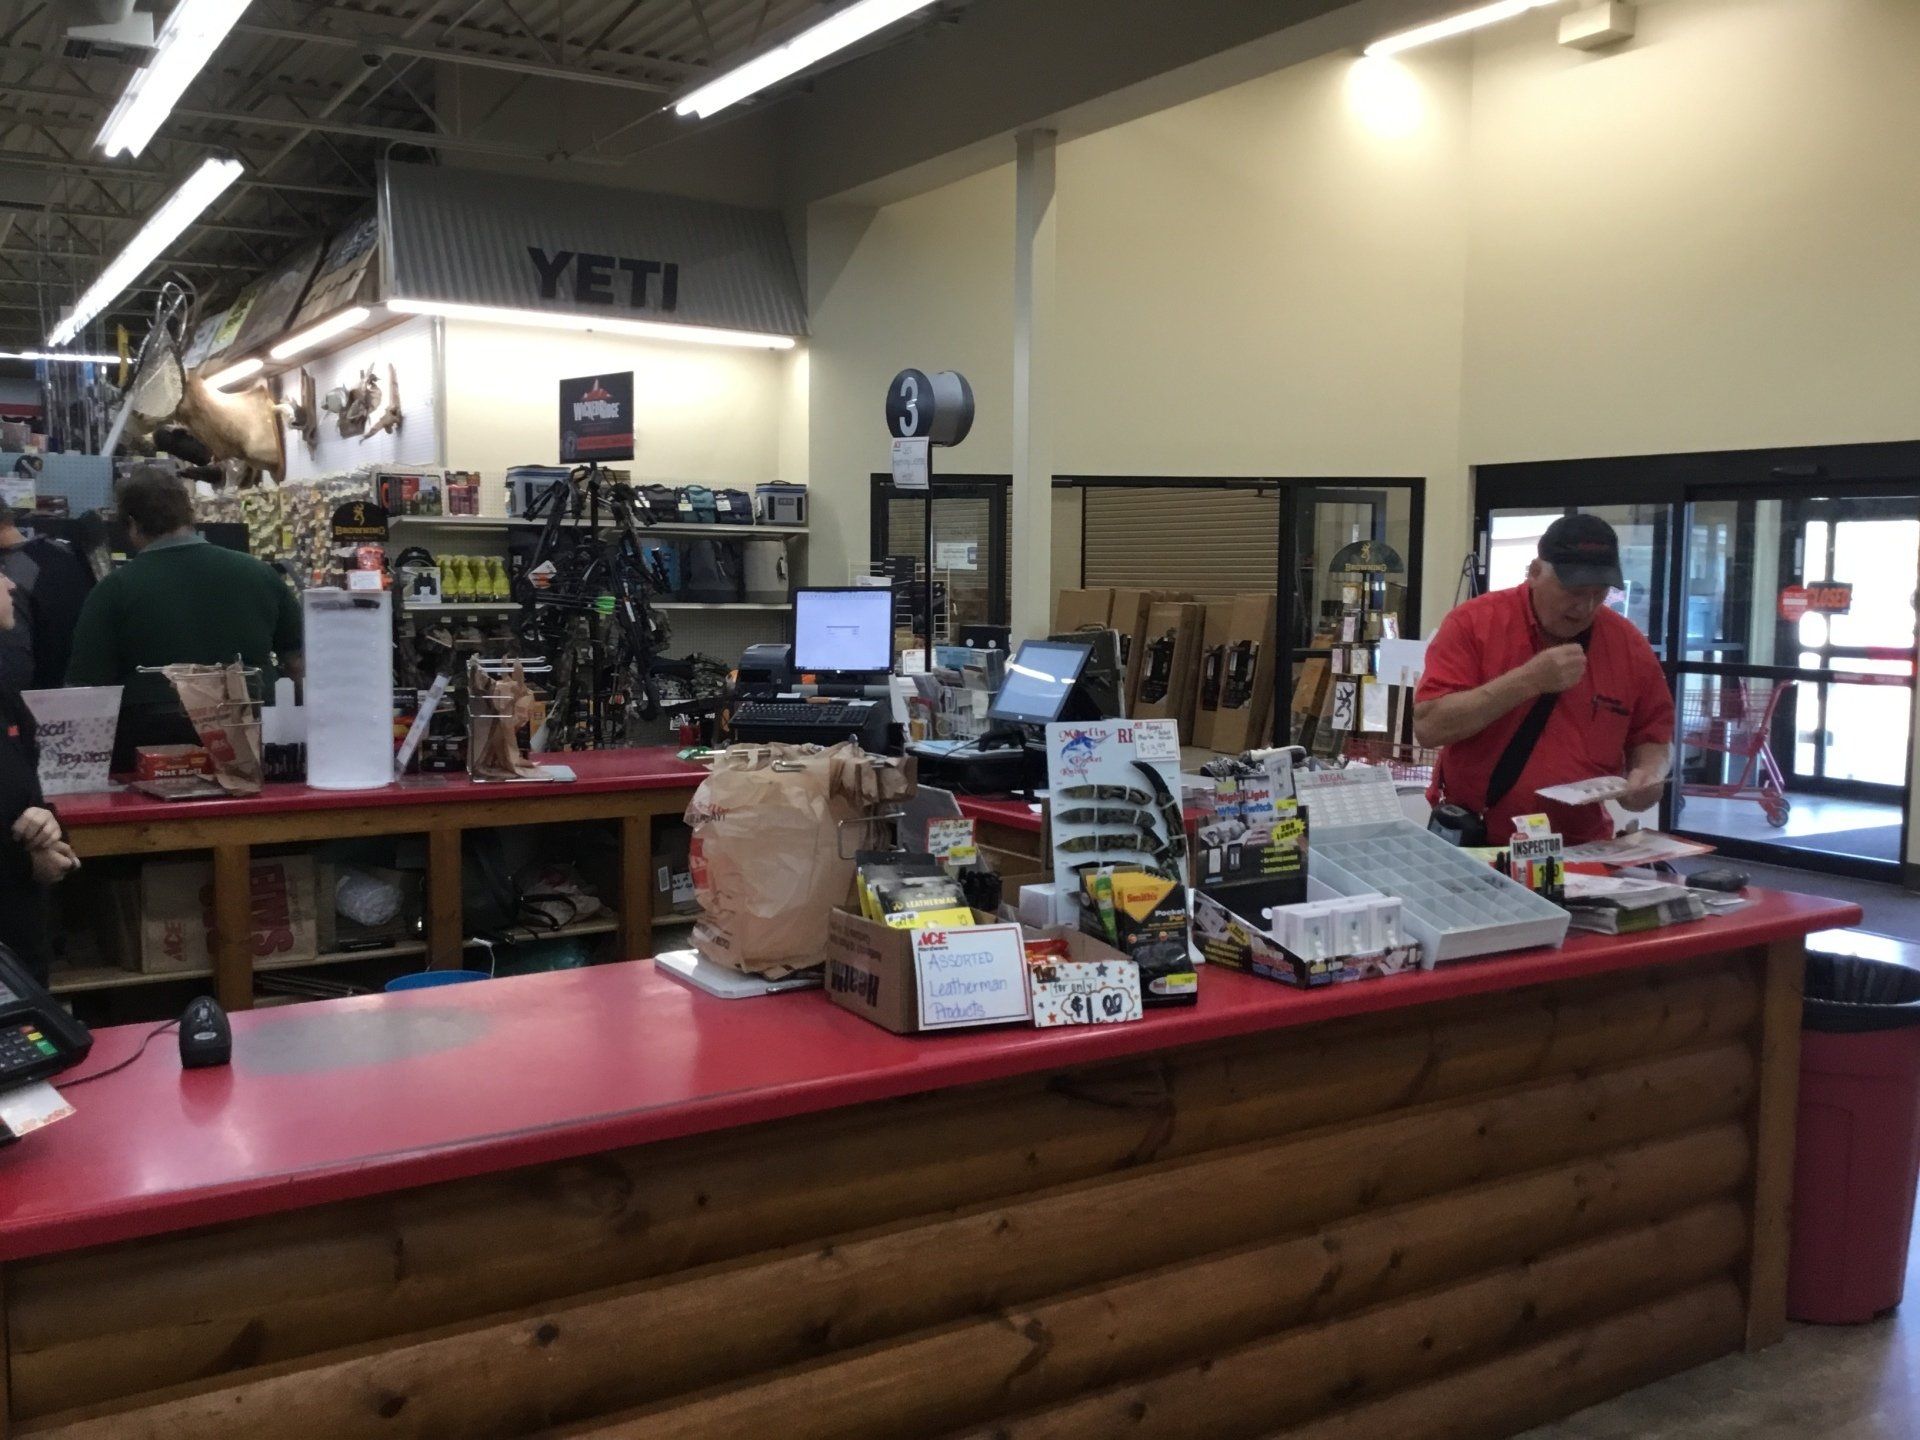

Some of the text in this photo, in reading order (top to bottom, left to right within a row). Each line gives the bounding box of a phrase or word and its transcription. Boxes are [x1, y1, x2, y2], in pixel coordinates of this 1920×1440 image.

[527, 247, 678, 312] YETI
[899, 376, 919, 437] 3
[335, 525, 386, 535] BROWNING
[1345, 563, 1387, 573] BROWNING
[154, 768, 176, 778] Nut
[1319, 773, 1345, 784] REGAL
[1513, 838, 1561, 856] INSPECTOR
[905, 896, 957, 909] LEATHERMAN
[1154, 908, 1186, 917] Pocket
[917, 931, 948, 946] ACE
[928, 951, 994, 971] ASSORTED
[929, 977, 1008, 998] Leatherman
[1070, 979, 1093, 993] only
[934, 1001, 987, 1019] Products
